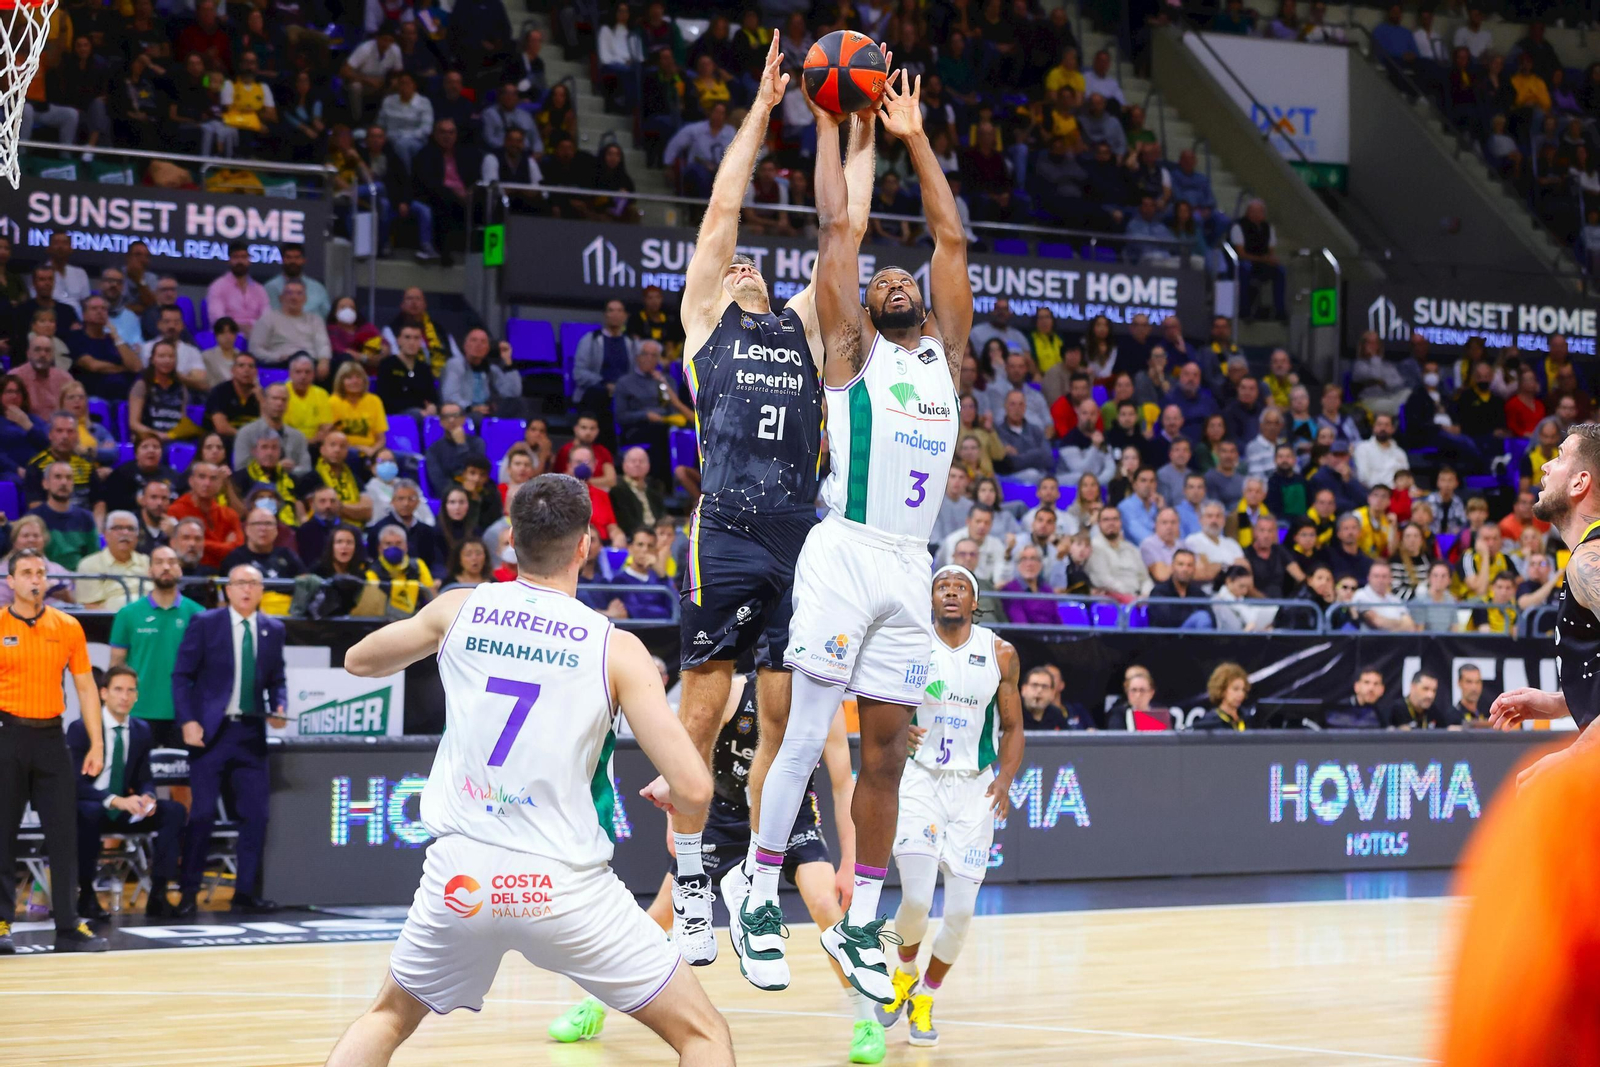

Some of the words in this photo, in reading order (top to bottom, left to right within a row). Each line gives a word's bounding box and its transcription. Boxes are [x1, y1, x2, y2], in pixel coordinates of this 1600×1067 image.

[28, 191, 177, 235] SUNSET
[185, 204, 305, 243] HOME
[28, 228, 182, 258] INRNATINAL
[247, 245, 283, 264] STA
[641, 238, 768, 278] SUT
[775, 248, 877, 285] HOE
[970, 265, 1080, 299] SUNSET
[1086, 271, 1178, 307] HOME
[1413, 297, 1513, 330] SUNSET
[1518, 305, 1598, 336] HOME
[733, 340, 803, 367] Lenoo
[1414, 327, 1513, 349] NTERNAONAL
[1517, 333, 1549, 352] REAL
[1566, 337, 1596, 355] TATE
[757, 404, 787, 441] 21
[904, 469, 930, 508] 3
[471, 606, 589, 642] BARREIRO
[465, 636, 580, 669] BENAHAVÍS
[301, 697, 384, 734] FINISHER
[948, 692, 979, 706] Uncaja
[485, 676, 541, 767] 7
[460, 776, 538, 808] Andalucía
[1269, 763, 1482, 823] HOVIMA
[1346, 831, 1409, 856] HOTELS
[491, 874, 553, 890] COSTA
[491, 893, 519, 905] DEL
[522, 892, 553, 904] SOL
[118, 918, 403, 939] DIS
[492, 904, 553, 919] MÁLAGA
